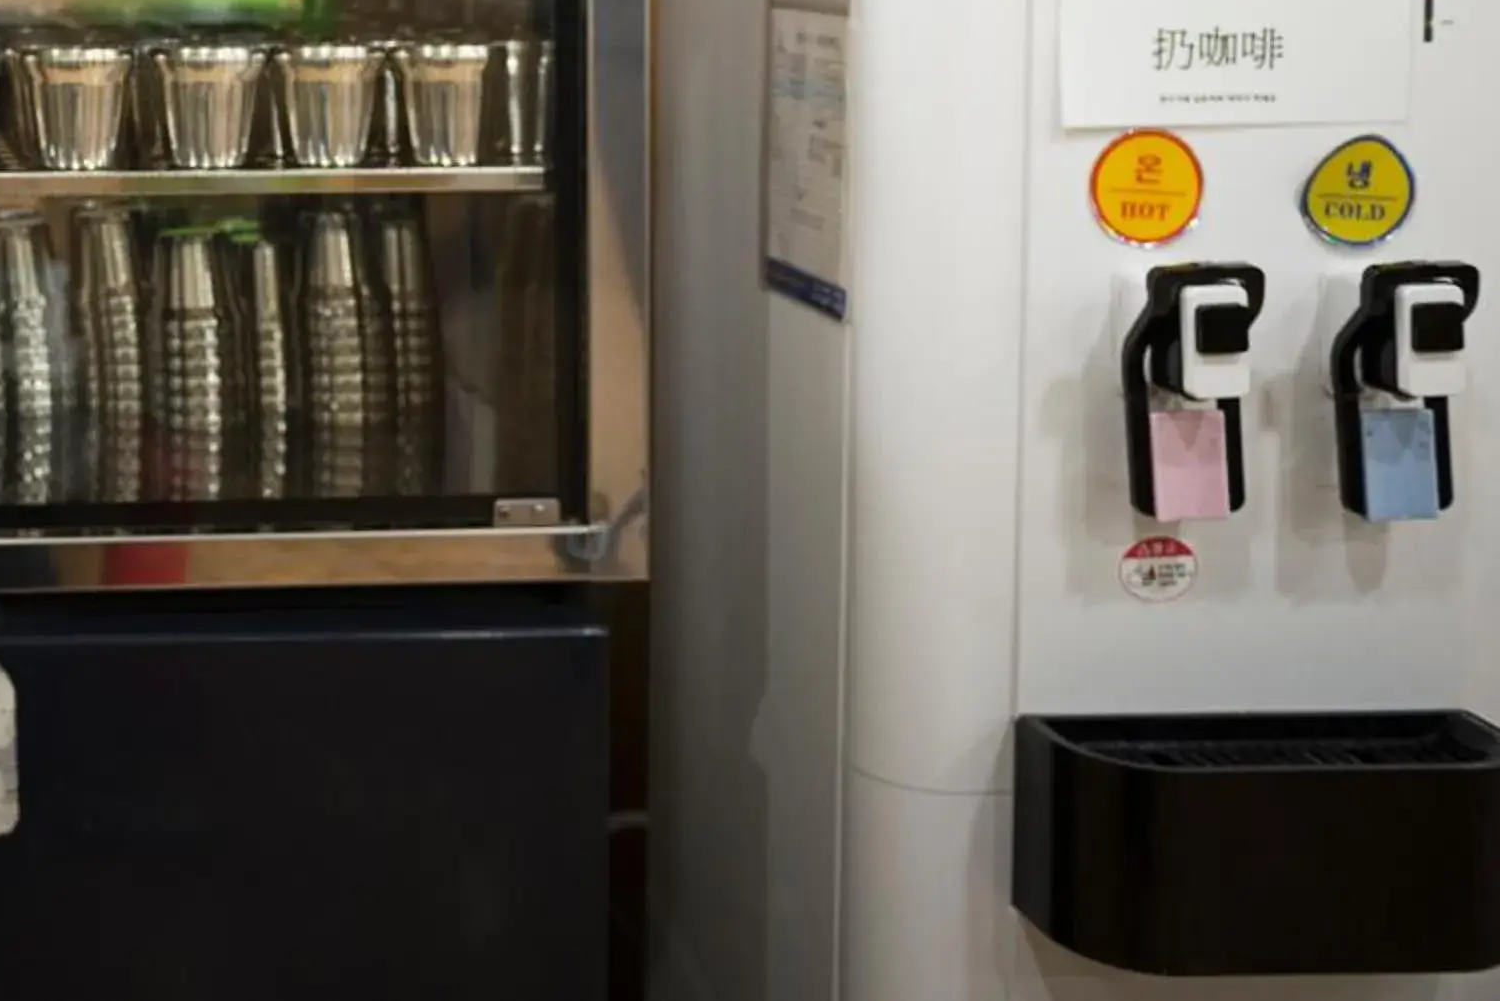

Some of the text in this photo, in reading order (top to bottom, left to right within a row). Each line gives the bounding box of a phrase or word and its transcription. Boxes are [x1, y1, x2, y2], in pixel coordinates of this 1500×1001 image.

[1152, 25, 1284, 71] 扔咖啡
[1120, 200, 1170, 221] HOT
[1323, 202, 1386, 222] COLD
